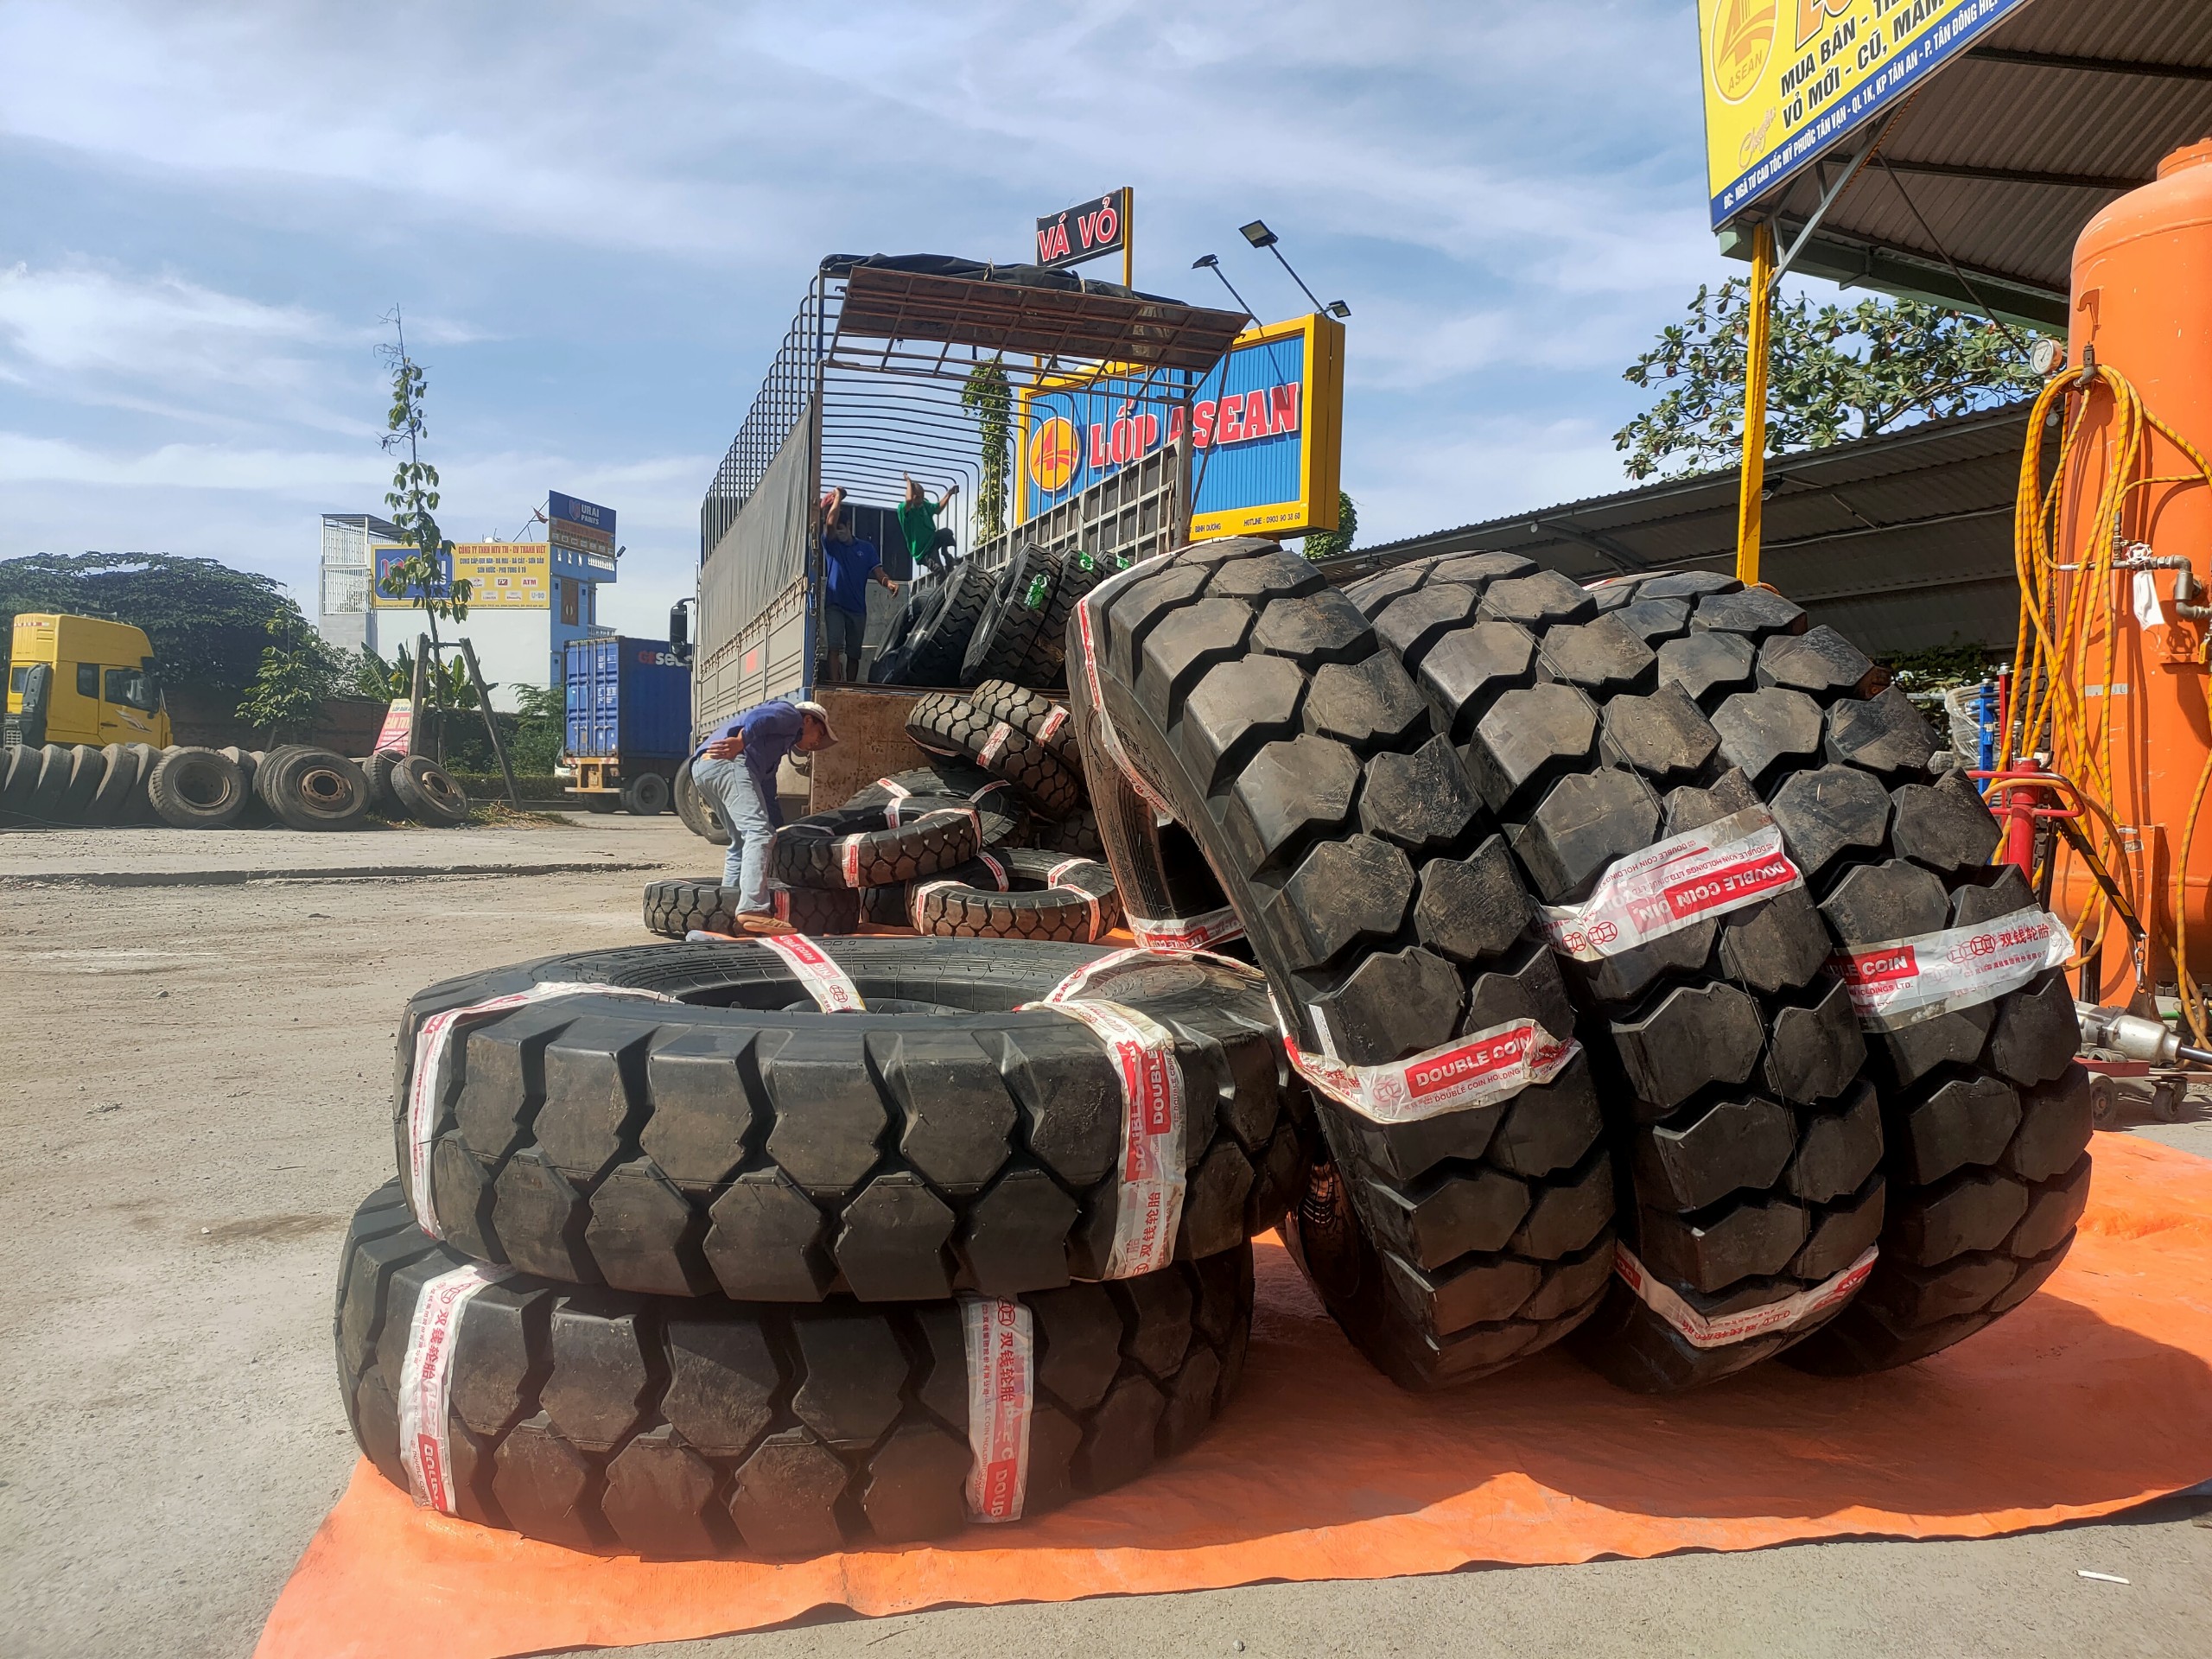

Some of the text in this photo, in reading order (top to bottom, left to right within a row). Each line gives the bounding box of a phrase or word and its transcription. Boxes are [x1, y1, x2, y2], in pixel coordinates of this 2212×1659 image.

[1728, 52, 1763, 92] ASEAN
[1781, 59, 1816, 98] MUA
[1821, 17, 1856, 72] BÁN
[1735, 178, 1748, 200] NGÃ
[1757, 164, 1769, 185] CAO
[1770, 152, 1782, 175] TỐC
[1783, 142, 1793, 165] MỸ
[1794, 128, 1816, 157] PHƯỚC
[1816, 118, 1831, 139] TÂN
[1831, 105, 1847, 130] VẠN
[1852, 95, 1862, 113] QL
[1876, 74, 1887, 93] KP
[1888, 62, 1904, 84] TÂN
[1905, 54, 1917, 73] AN
[1933, 26, 1950, 51] TÂN
[1952, 7, 1977, 35] ĐÔNG
[1783, 92, 1803, 129] VỎ
[1808, 67, 1840, 111] MỚI
[1038, 197, 1117, 262] VÁ VỎ
[1090, 382, 1300, 468] LỐP ASEAN
[581, 504, 600, 518] URAI
[1243, 517, 1262, 526] HOTLINE
[1639, 855, 1657, 868] COIN
[1660, 841, 1688, 860] DOUBLE
[1686, 855, 1722, 874] HOLDINGS
[1738, 844, 1767, 860] DOUBLE
[1676, 861, 1787, 907] DOUBLE COIN
[1999, 924, 2050, 948] 双钱轮胎
[1862, 956, 1908, 976] COIN
[1896, 982, 1913, 990] LTD.
[1415, 1036, 1530, 1087] DOUBLE COIN
[1147, 1047, 1164, 1124] DOUBLE
[1434, 1067, 1522, 1103] DOUBLE COIN HOLDING
[1140, 1192, 1161, 1258] 双钱轮胎
[423, 1308, 448, 1380] 双钱轮胎
[999, 1332, 1015, 1402] 双钱轮胎
